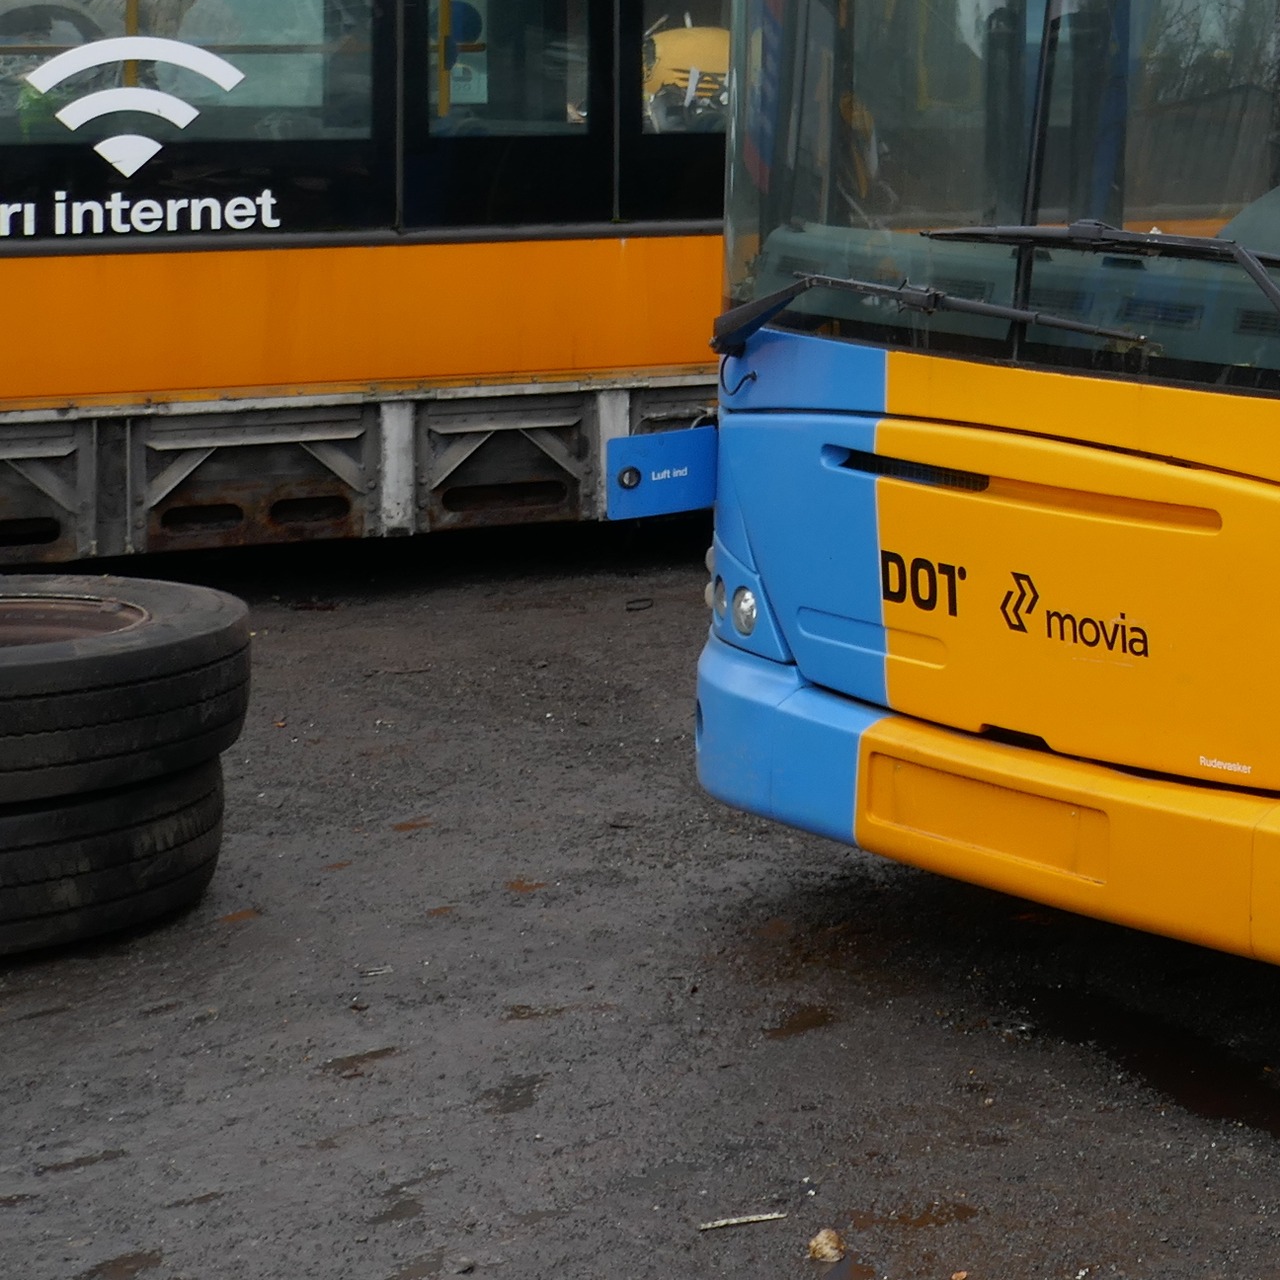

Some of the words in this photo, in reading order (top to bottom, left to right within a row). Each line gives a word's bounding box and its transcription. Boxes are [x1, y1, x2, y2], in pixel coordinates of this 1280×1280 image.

[54, 189, 280, 235] internet
[652, 469, 670, 481] Luft
[881, 549, 967, 617] DOT
[1046, 612, 1149, 657] movia
